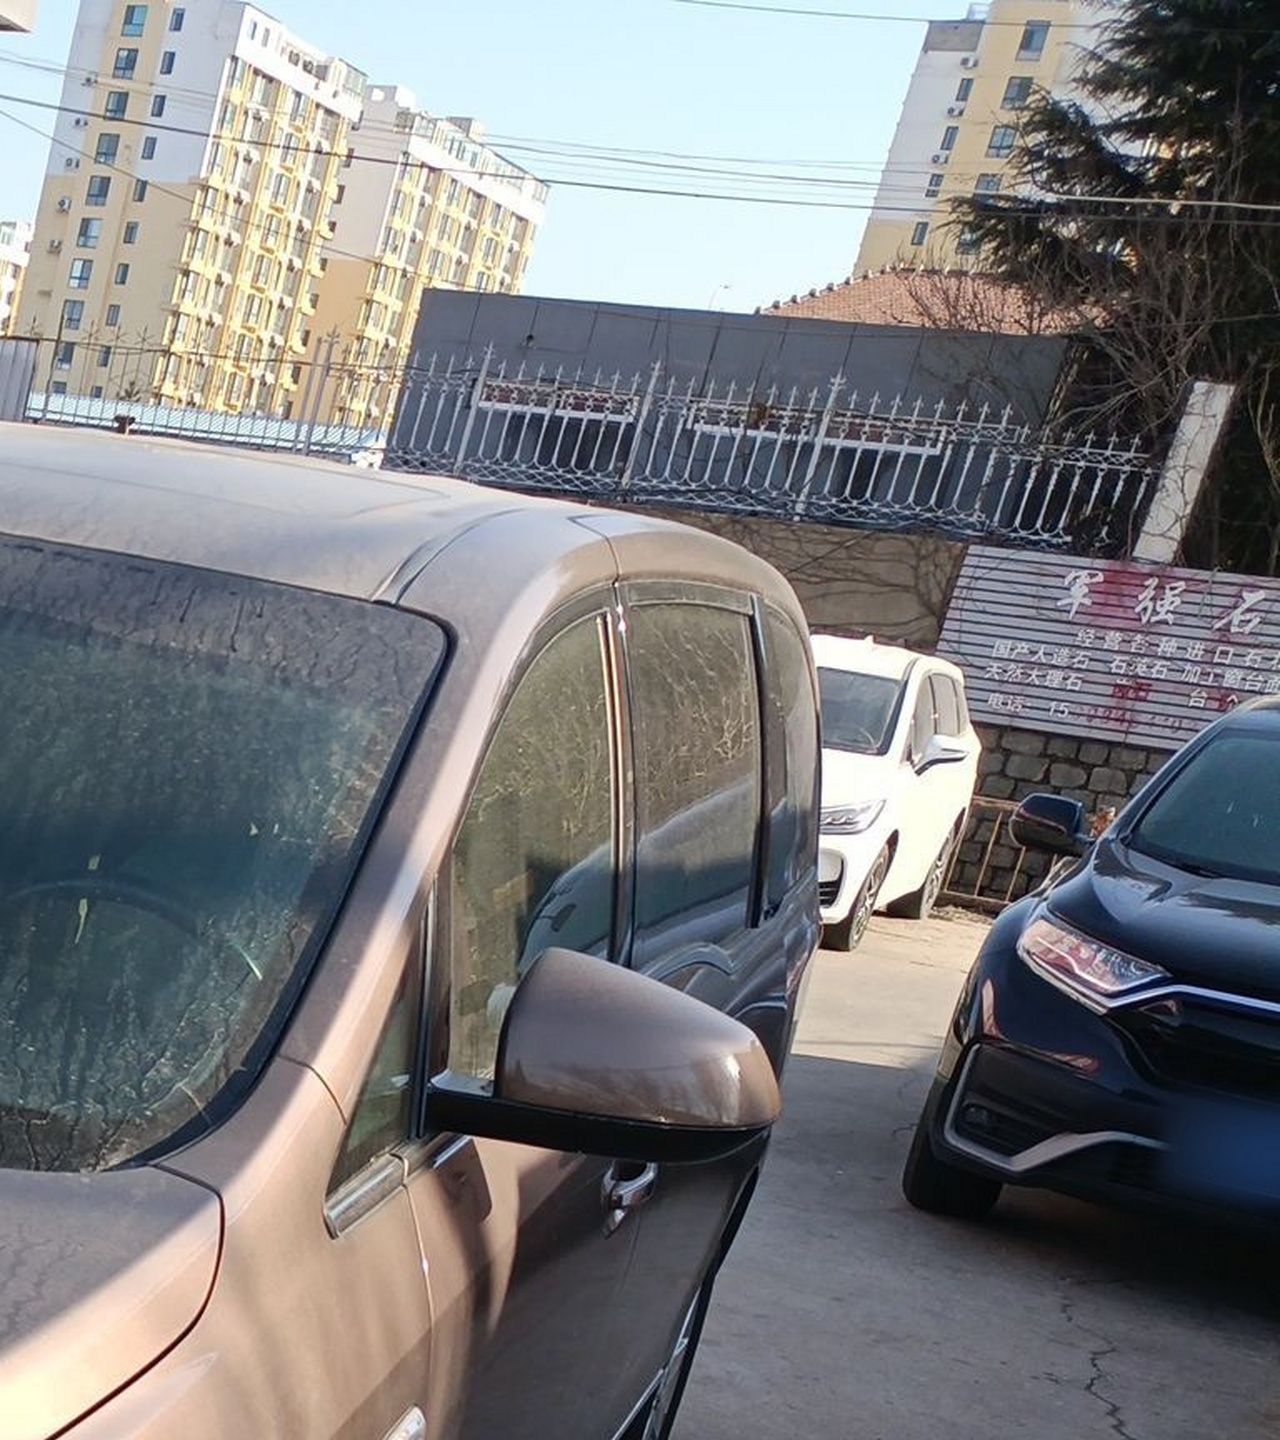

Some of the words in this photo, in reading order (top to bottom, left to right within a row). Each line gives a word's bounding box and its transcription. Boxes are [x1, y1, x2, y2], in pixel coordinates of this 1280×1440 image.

[984, 662, 1084, 691] 天然大理石
[992, 640, 1092, 669] 国产人造石
[1109, 655, 1171, 680] 石英石
